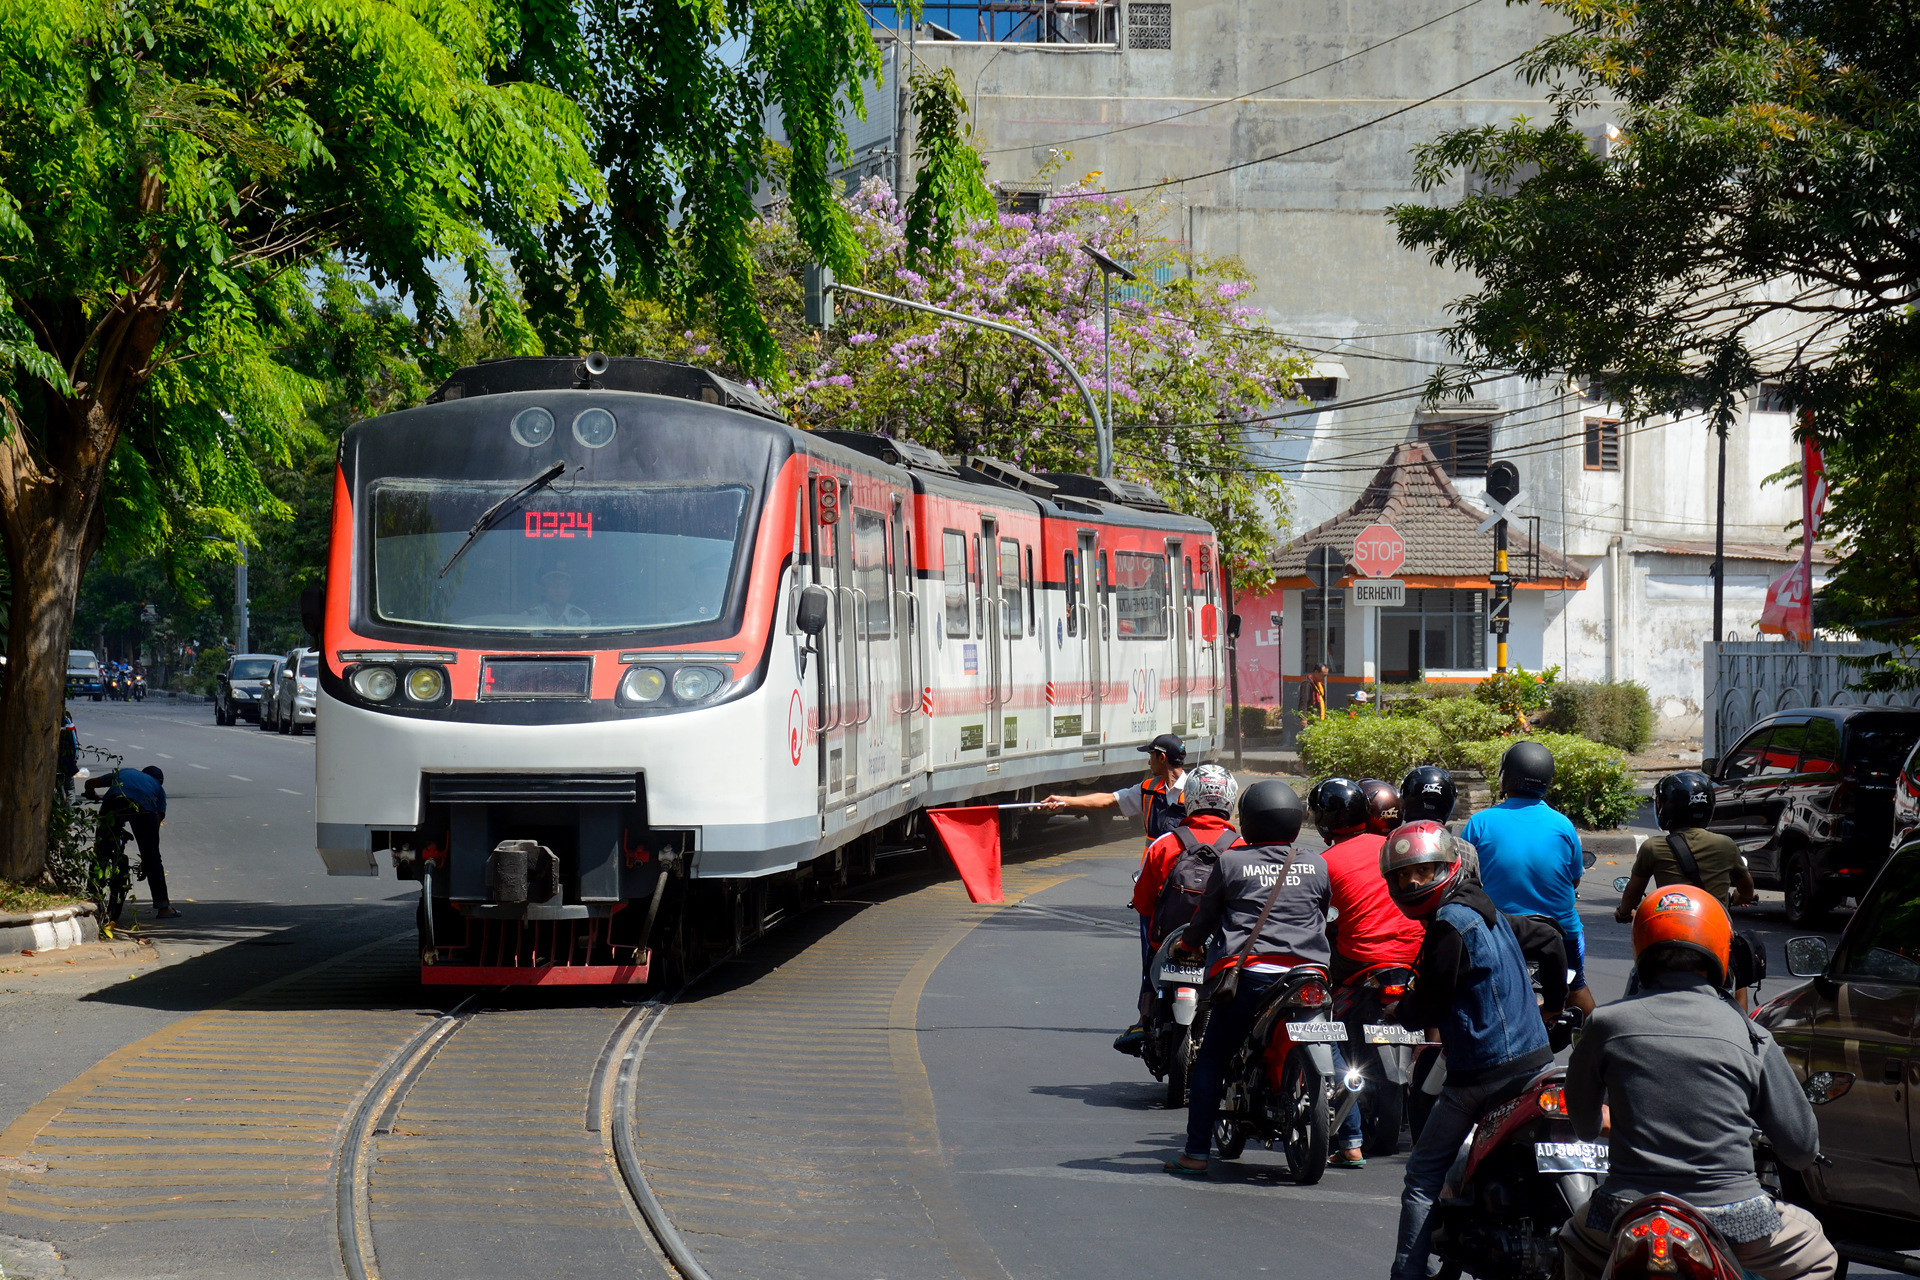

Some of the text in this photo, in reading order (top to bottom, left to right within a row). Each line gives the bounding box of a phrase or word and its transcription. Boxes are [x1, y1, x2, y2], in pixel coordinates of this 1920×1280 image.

[1356, 541, 1403, 561] STOP
[1357, 586, 1401, 600] BERHENTI
[1255, 628, 1284, 647] LE
[1242, 864, 1316, 878] MANCHSTER
[1260, 876, 1301, 887] UNED
[1163, 964, 1176, 973] AD
[1288, 1021, 1345, 1034] AD 4229 CZ
[1364, 1025, 1377, 1035] AD
[1537, 1143, 1553, 1157] AD
